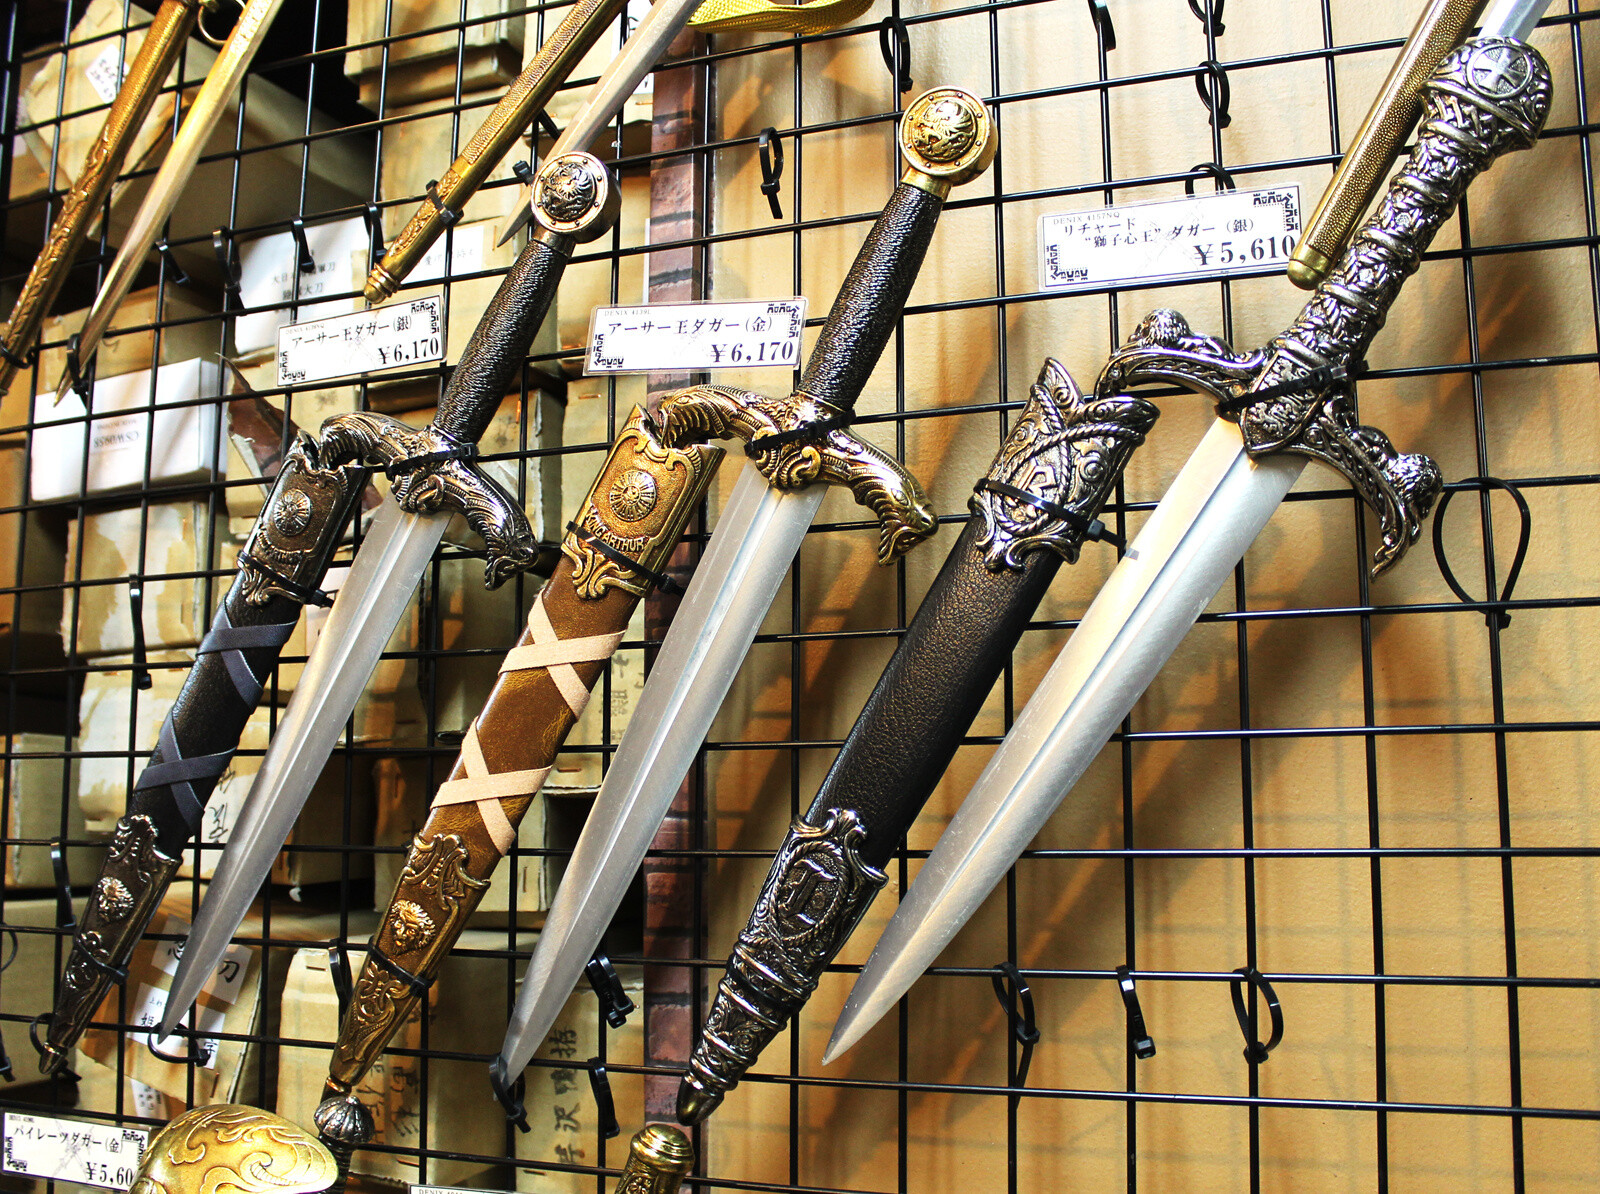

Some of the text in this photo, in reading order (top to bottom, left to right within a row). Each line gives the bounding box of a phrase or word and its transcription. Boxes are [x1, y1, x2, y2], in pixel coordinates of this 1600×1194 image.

[1053, 215, 1083, 225] DENIX
[1064, 218, 1136, 236] リチャード
[1194, 234, 1296, 266] ¥5,610
[604, 309, 628, 317] DENIX
[378, 337, 439, 364] ¥6,170
[709, 340, 795, 363] ¥6,170
[585, 505, 645, 552] KING ARTHUR
[13, 1125, 124, 1154] パイレーツダガー（金）
[85, 1161, 134, 1187] ¥5,60
